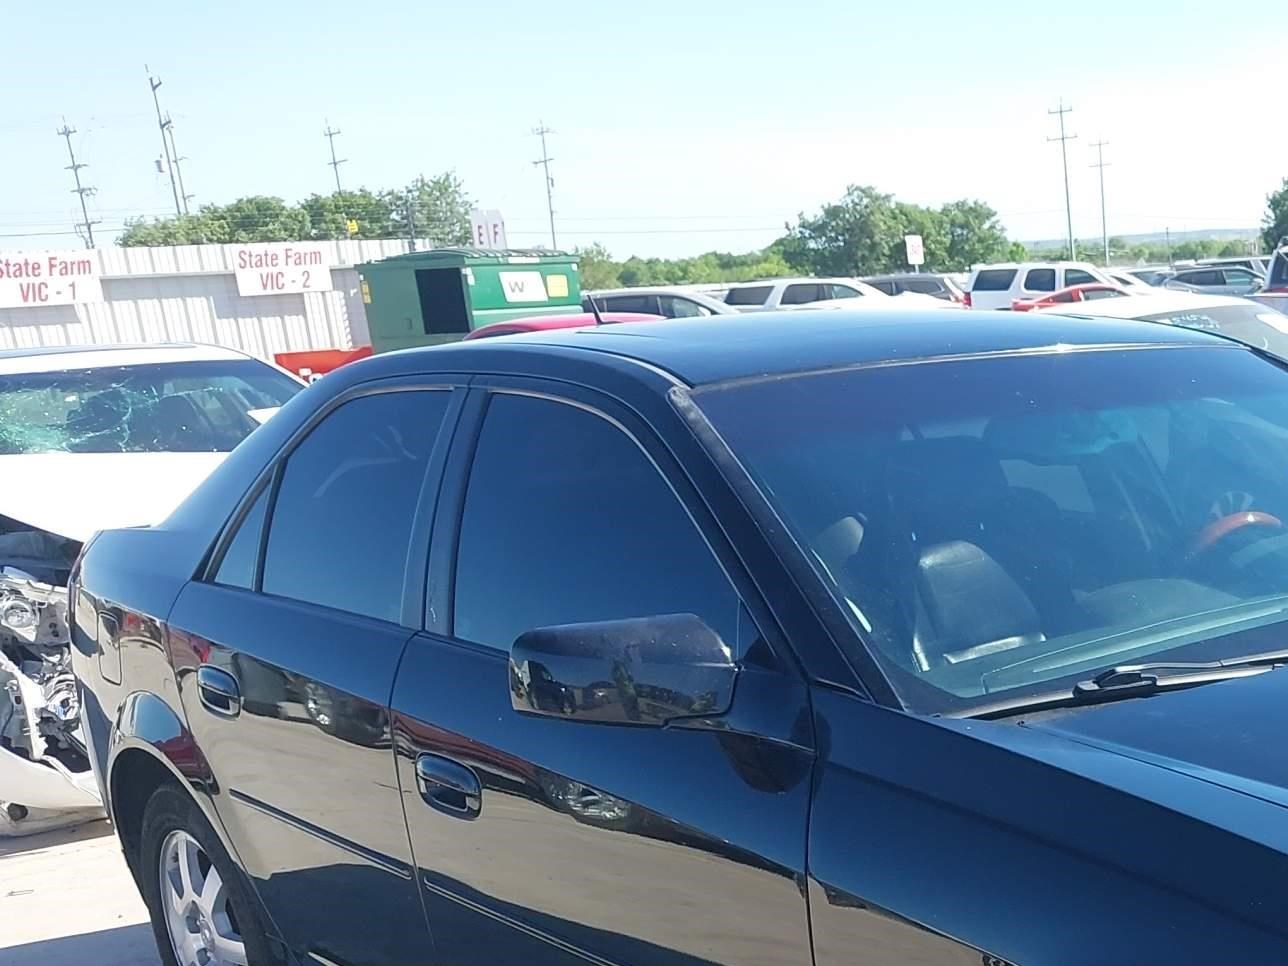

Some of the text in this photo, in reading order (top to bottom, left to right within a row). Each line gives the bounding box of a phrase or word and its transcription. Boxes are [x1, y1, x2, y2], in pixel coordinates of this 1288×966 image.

[477, 223, 499, 245] E F
[48, 256, 92, 277] Farm
[238, 248, 322, 269] State Farm
[260, 271, 285, 290] VIC
[302, 270, 311, 289] 2
[19, 281, 48, 302] VIC
[68, 281, 76, 301] 1
